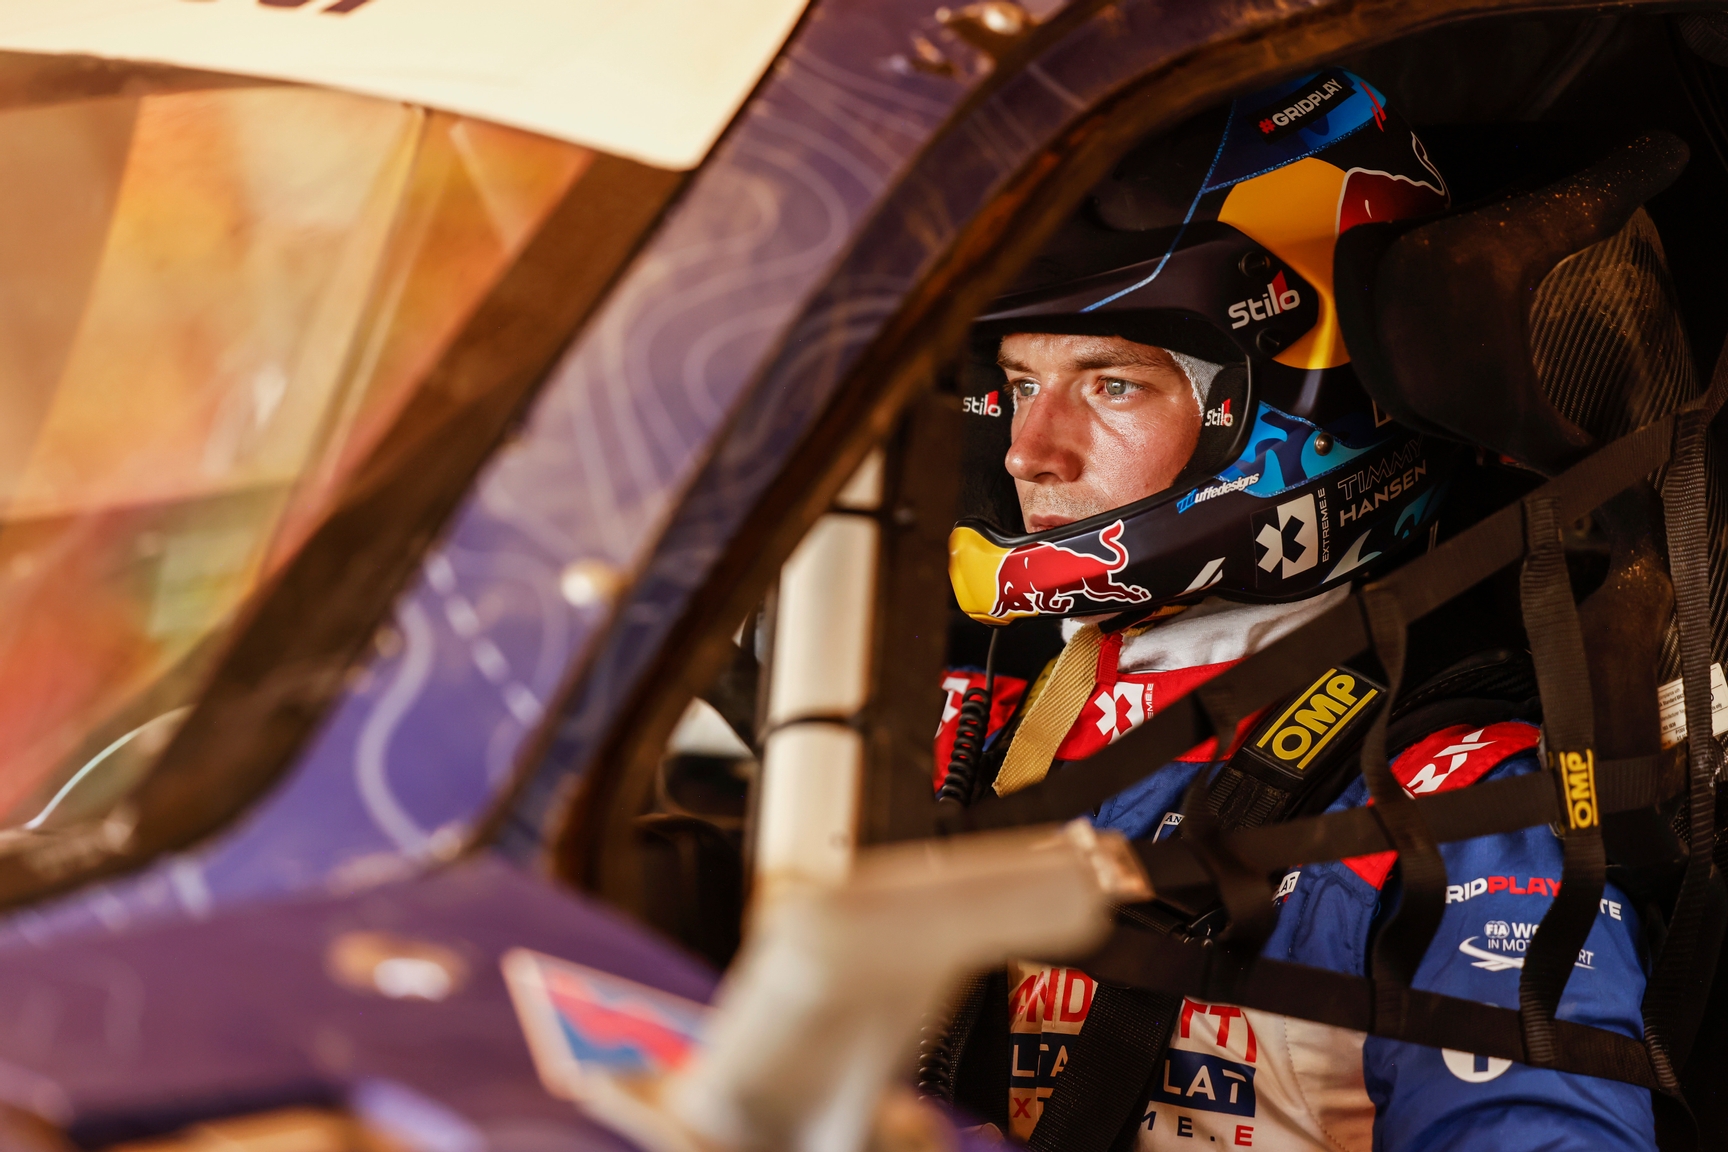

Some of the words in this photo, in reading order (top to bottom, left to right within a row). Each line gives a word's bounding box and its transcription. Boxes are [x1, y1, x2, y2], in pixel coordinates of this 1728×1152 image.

[1258, 78, 1343, 135] #GRIDPLAY
[1228, 270, 1300, 329] Stilo
[962, 390, 1001, 418] Stilo
[1205, 399, 1233, 427] Stilo
[1338, 432, 1424, 500] TIMMY
[1340, 459, 1426, 527] HANSEN
[1317, 487, 1329, 562] EXTREME.E
[1145, 683, 1154, 719] EME.E
[1272, 674, 1356, 760] OMP
[1566, 751, 1592, 828] OMP
[1446, 875, 1563, 904] RIDPLAY
[1485, 924, 1508, 936] FIA
[1488, 938, 1500, 949] IN
